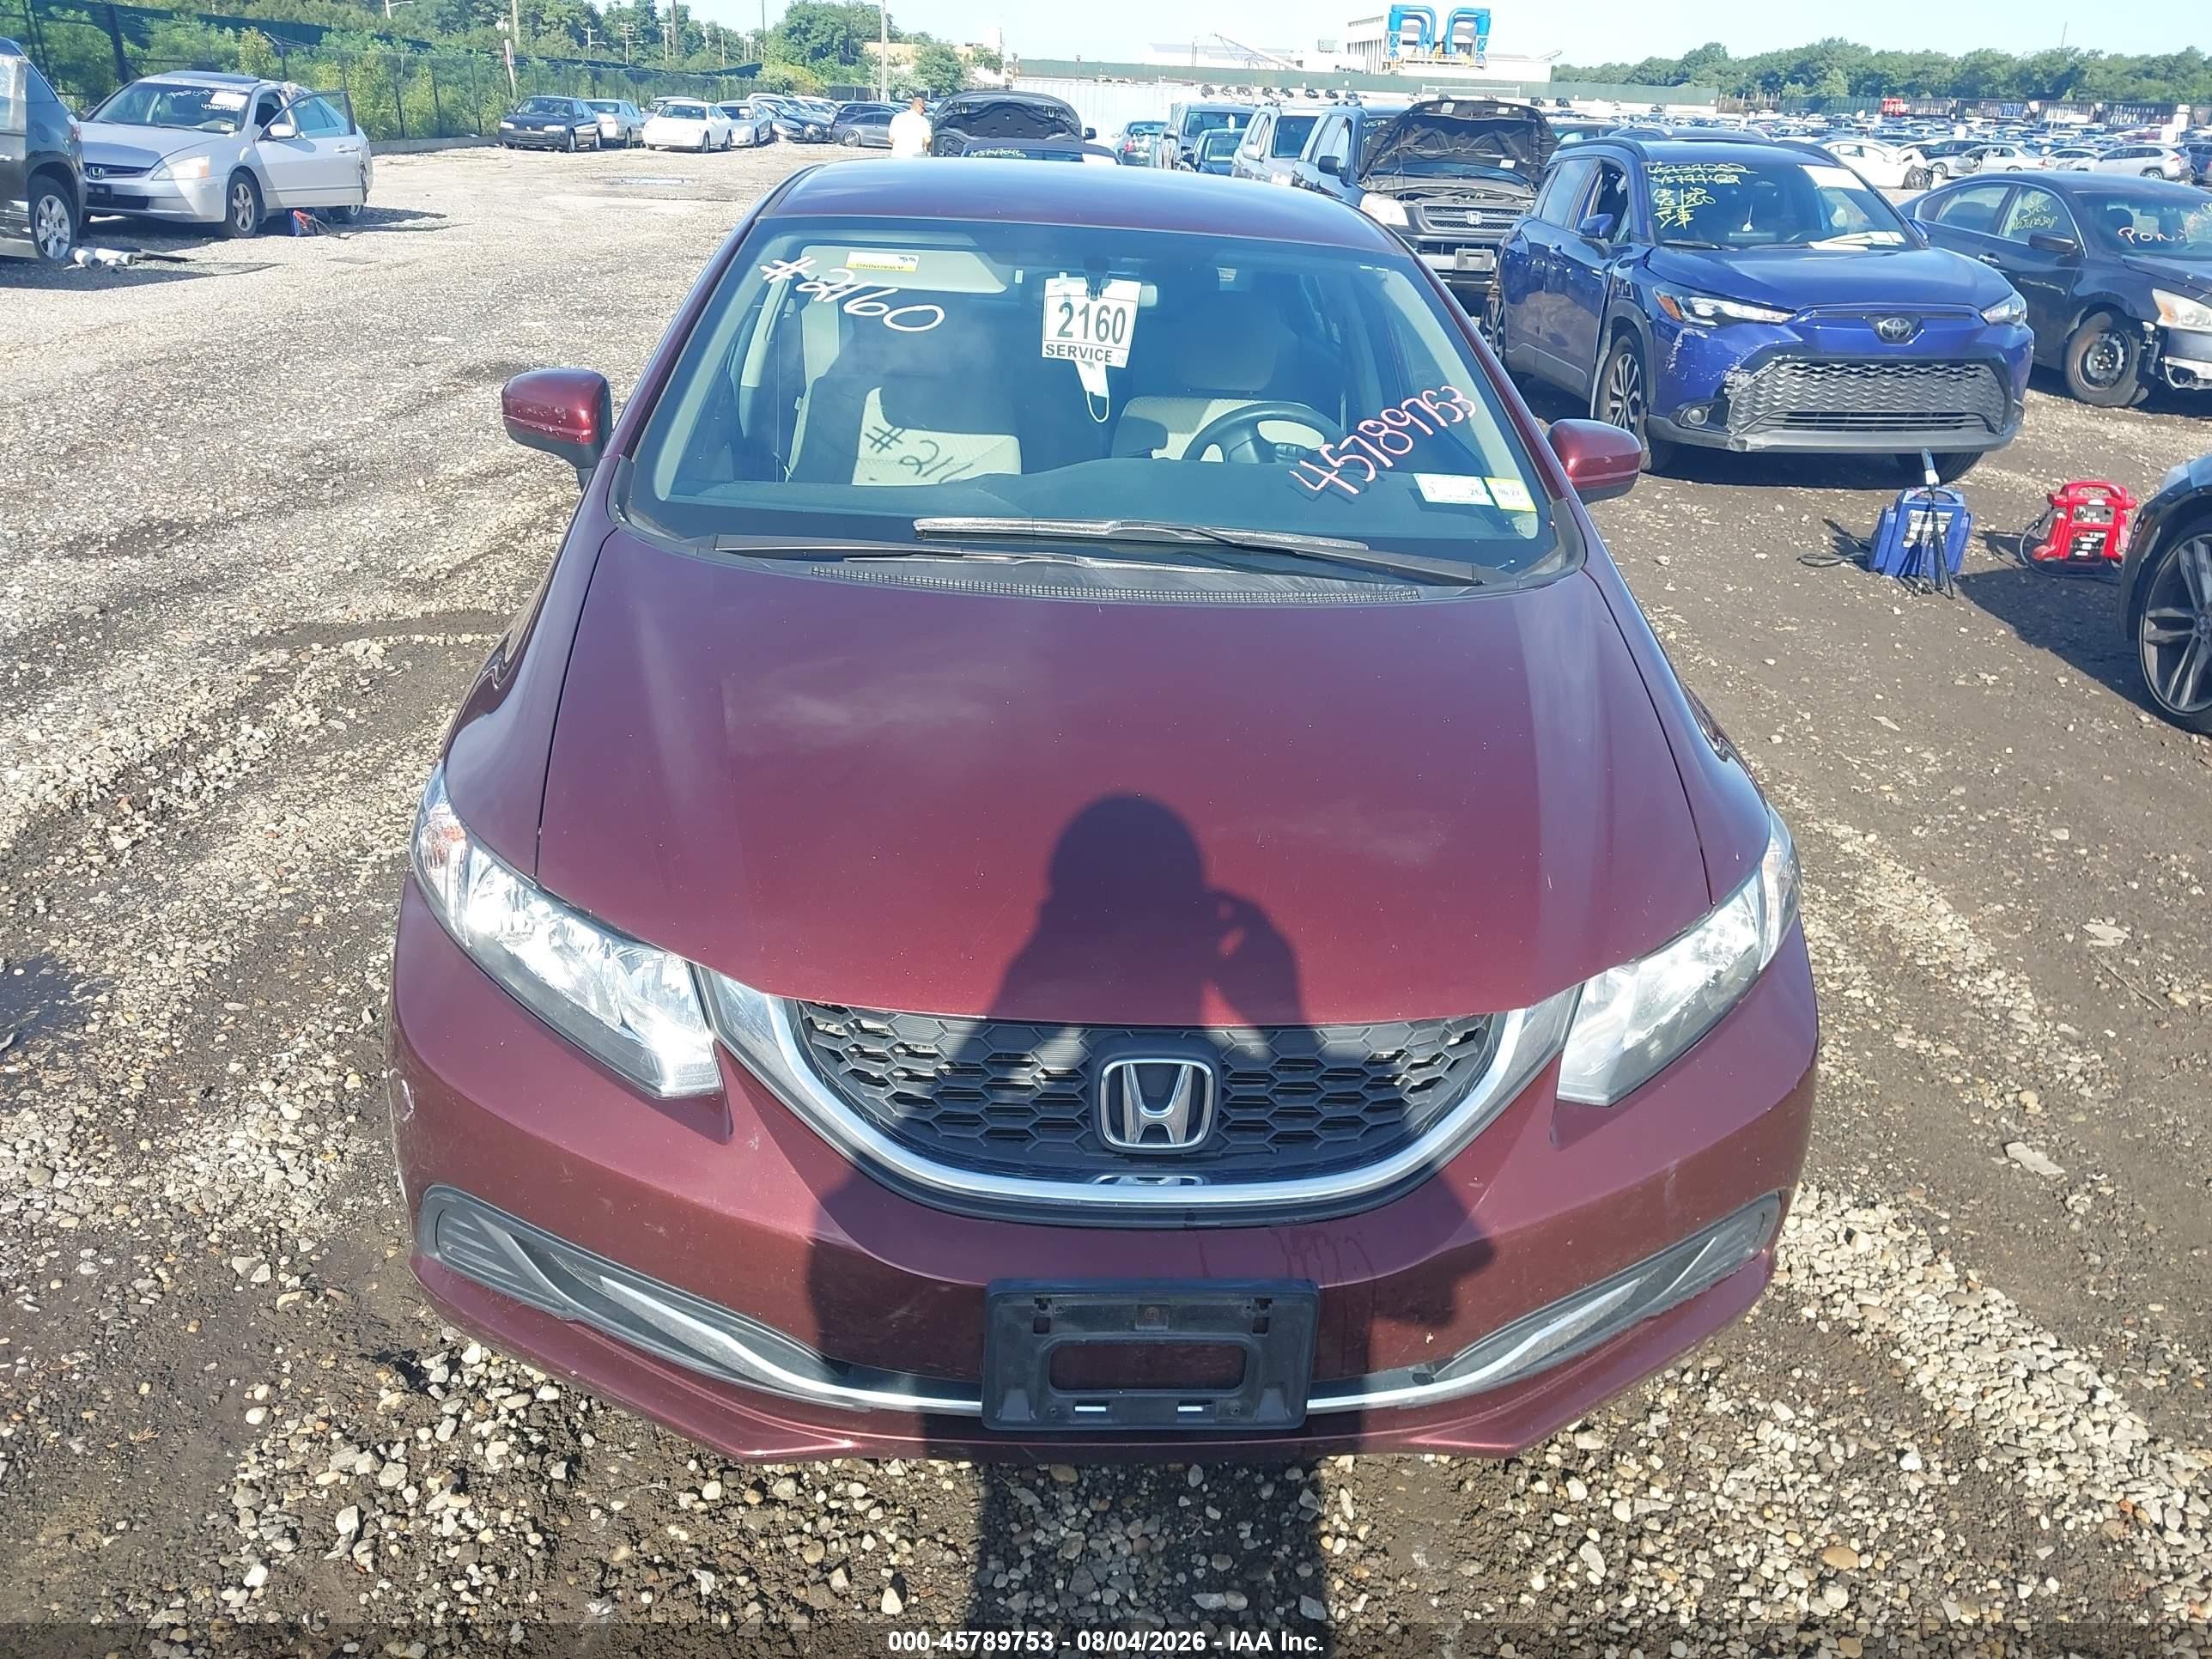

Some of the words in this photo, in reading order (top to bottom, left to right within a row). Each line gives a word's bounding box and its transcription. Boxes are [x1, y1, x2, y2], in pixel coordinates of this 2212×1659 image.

[1056, 301, 1127, 344] 2160
[1045, 343, 1113, 363] SERVICE
[1289, 385, 1476, 495] 45789753
